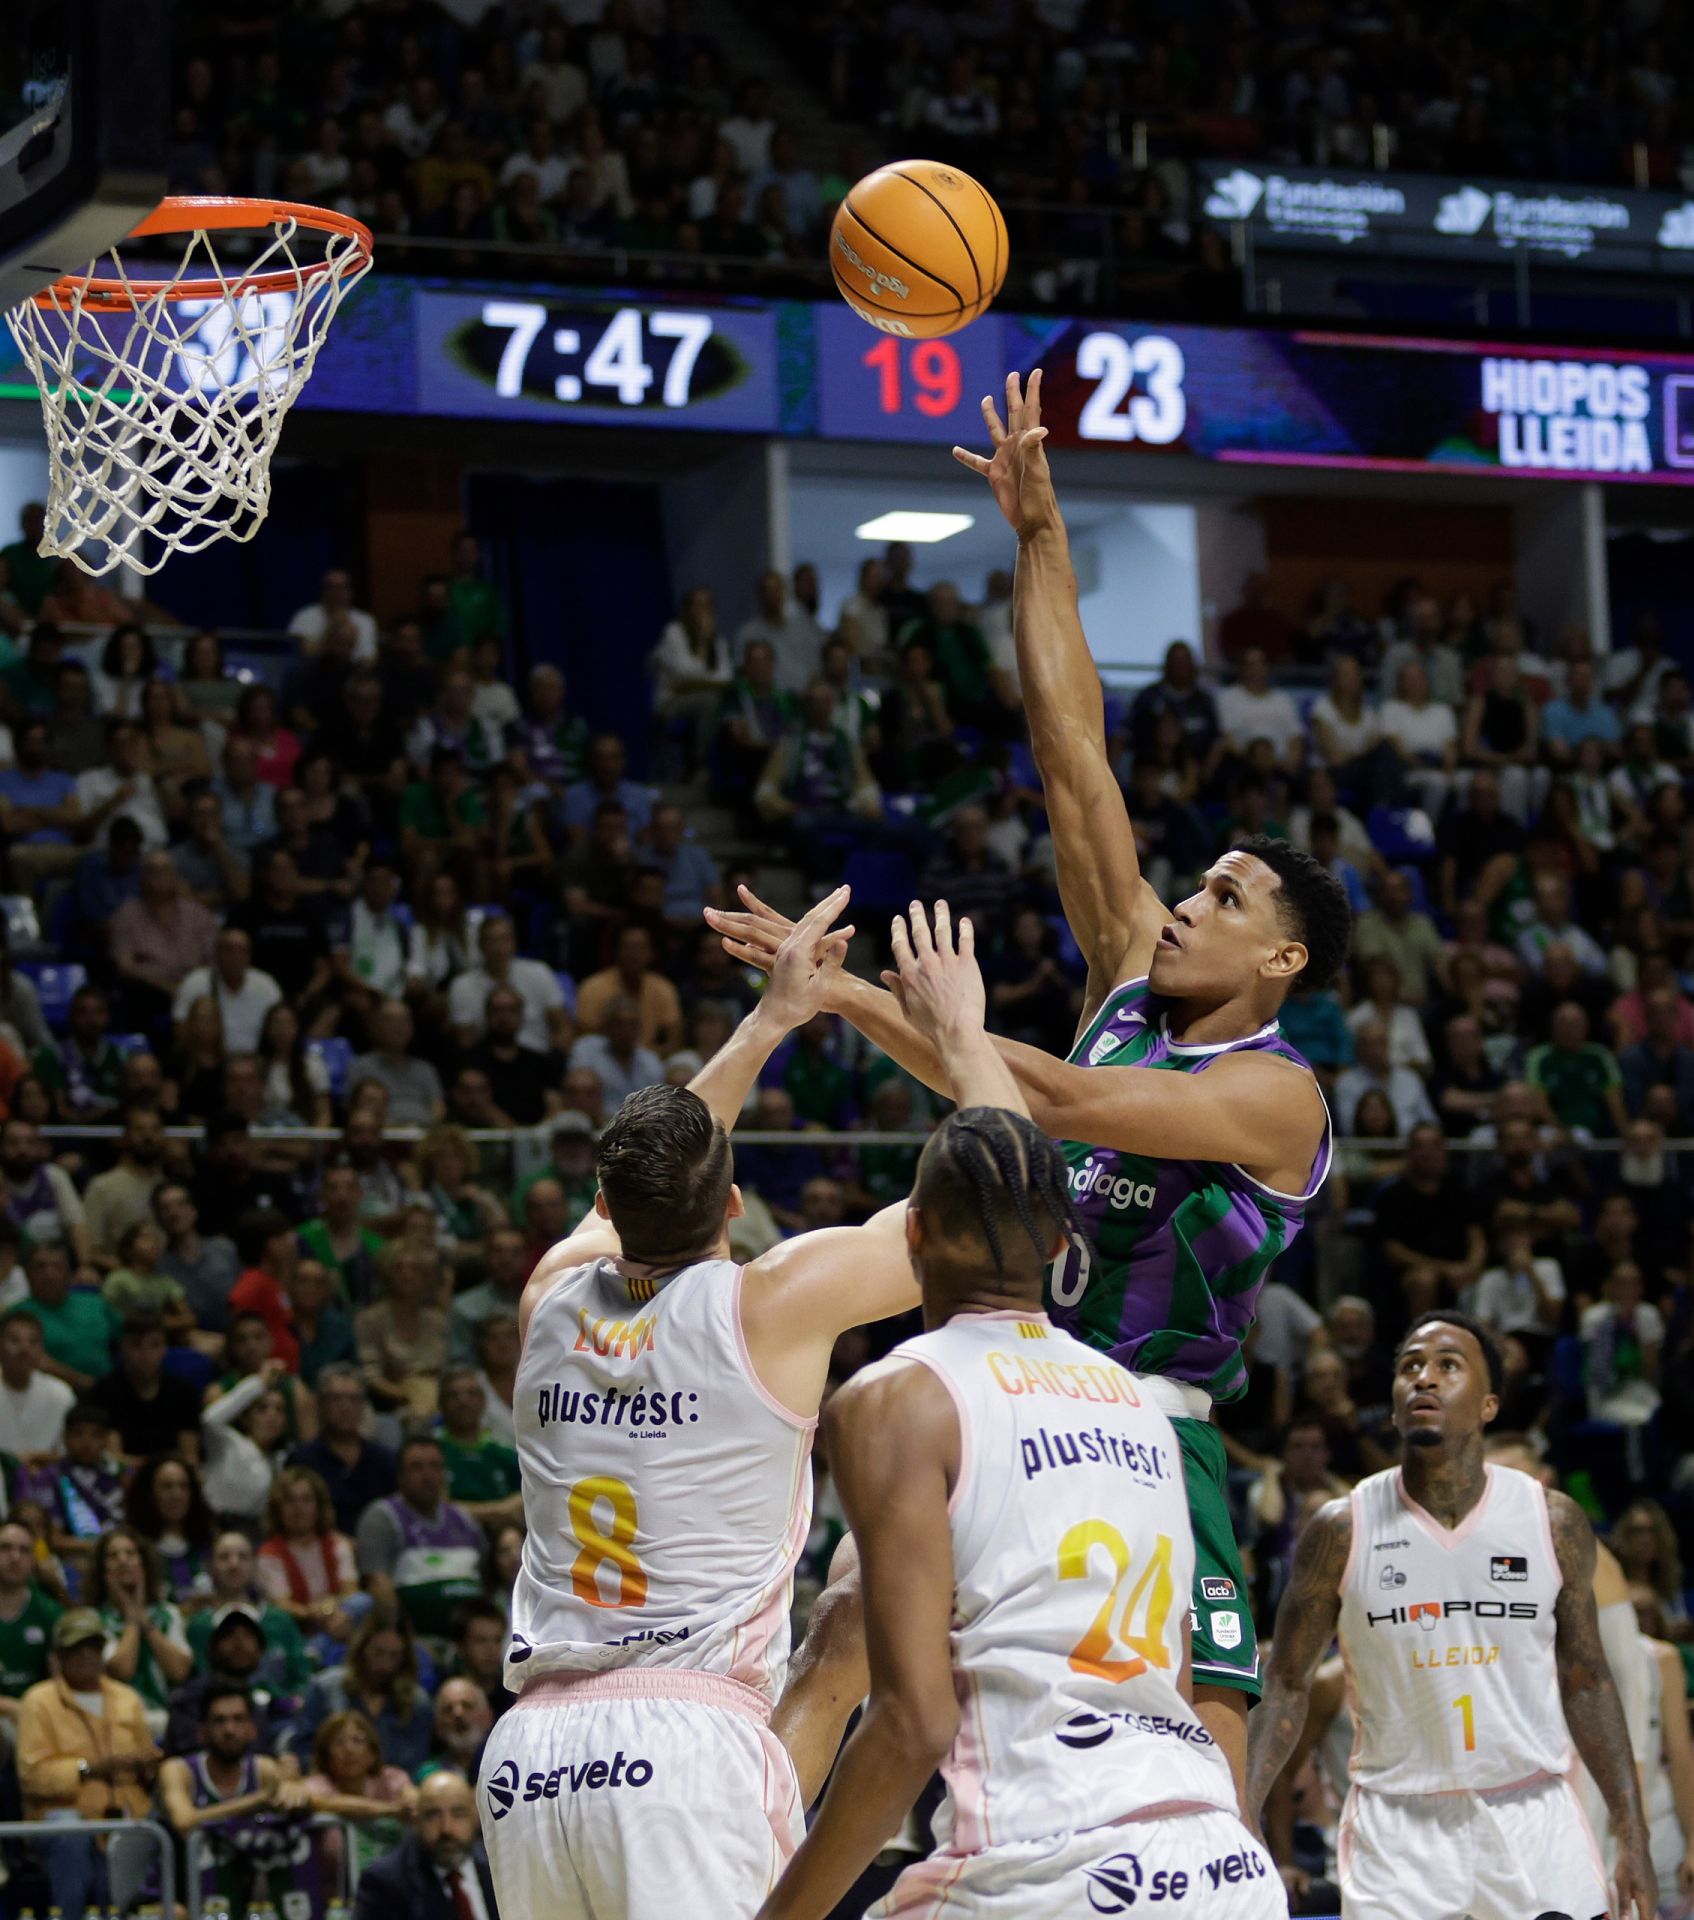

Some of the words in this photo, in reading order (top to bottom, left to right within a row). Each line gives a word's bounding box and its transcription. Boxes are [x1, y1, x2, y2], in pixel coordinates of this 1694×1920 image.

[481, 301, 713, 407] 7:47
[863, 337, 963, 416] 19
[1076, 332, 1187, 445] 23
[1481, 356, 1651, 420] HIOPOS
[1499, 414, 1653, 473] LLEIDA
[986, 1350, 1142, 1409] CAICEDO
[628, 1430, 638, 1439] de
[640, 1430, 667, 1440] Lleida
[567, 1475, 650, 1608] 8
[1057, 1518, 1174, 1684] 24
[1207, 1585, 1230, 1597] acb
[1412, 1646, 1500, 1669] LLEIDA
[1452, 1694, 1476, 1751] 1
[523, 1751, 654, 1802] serveto
